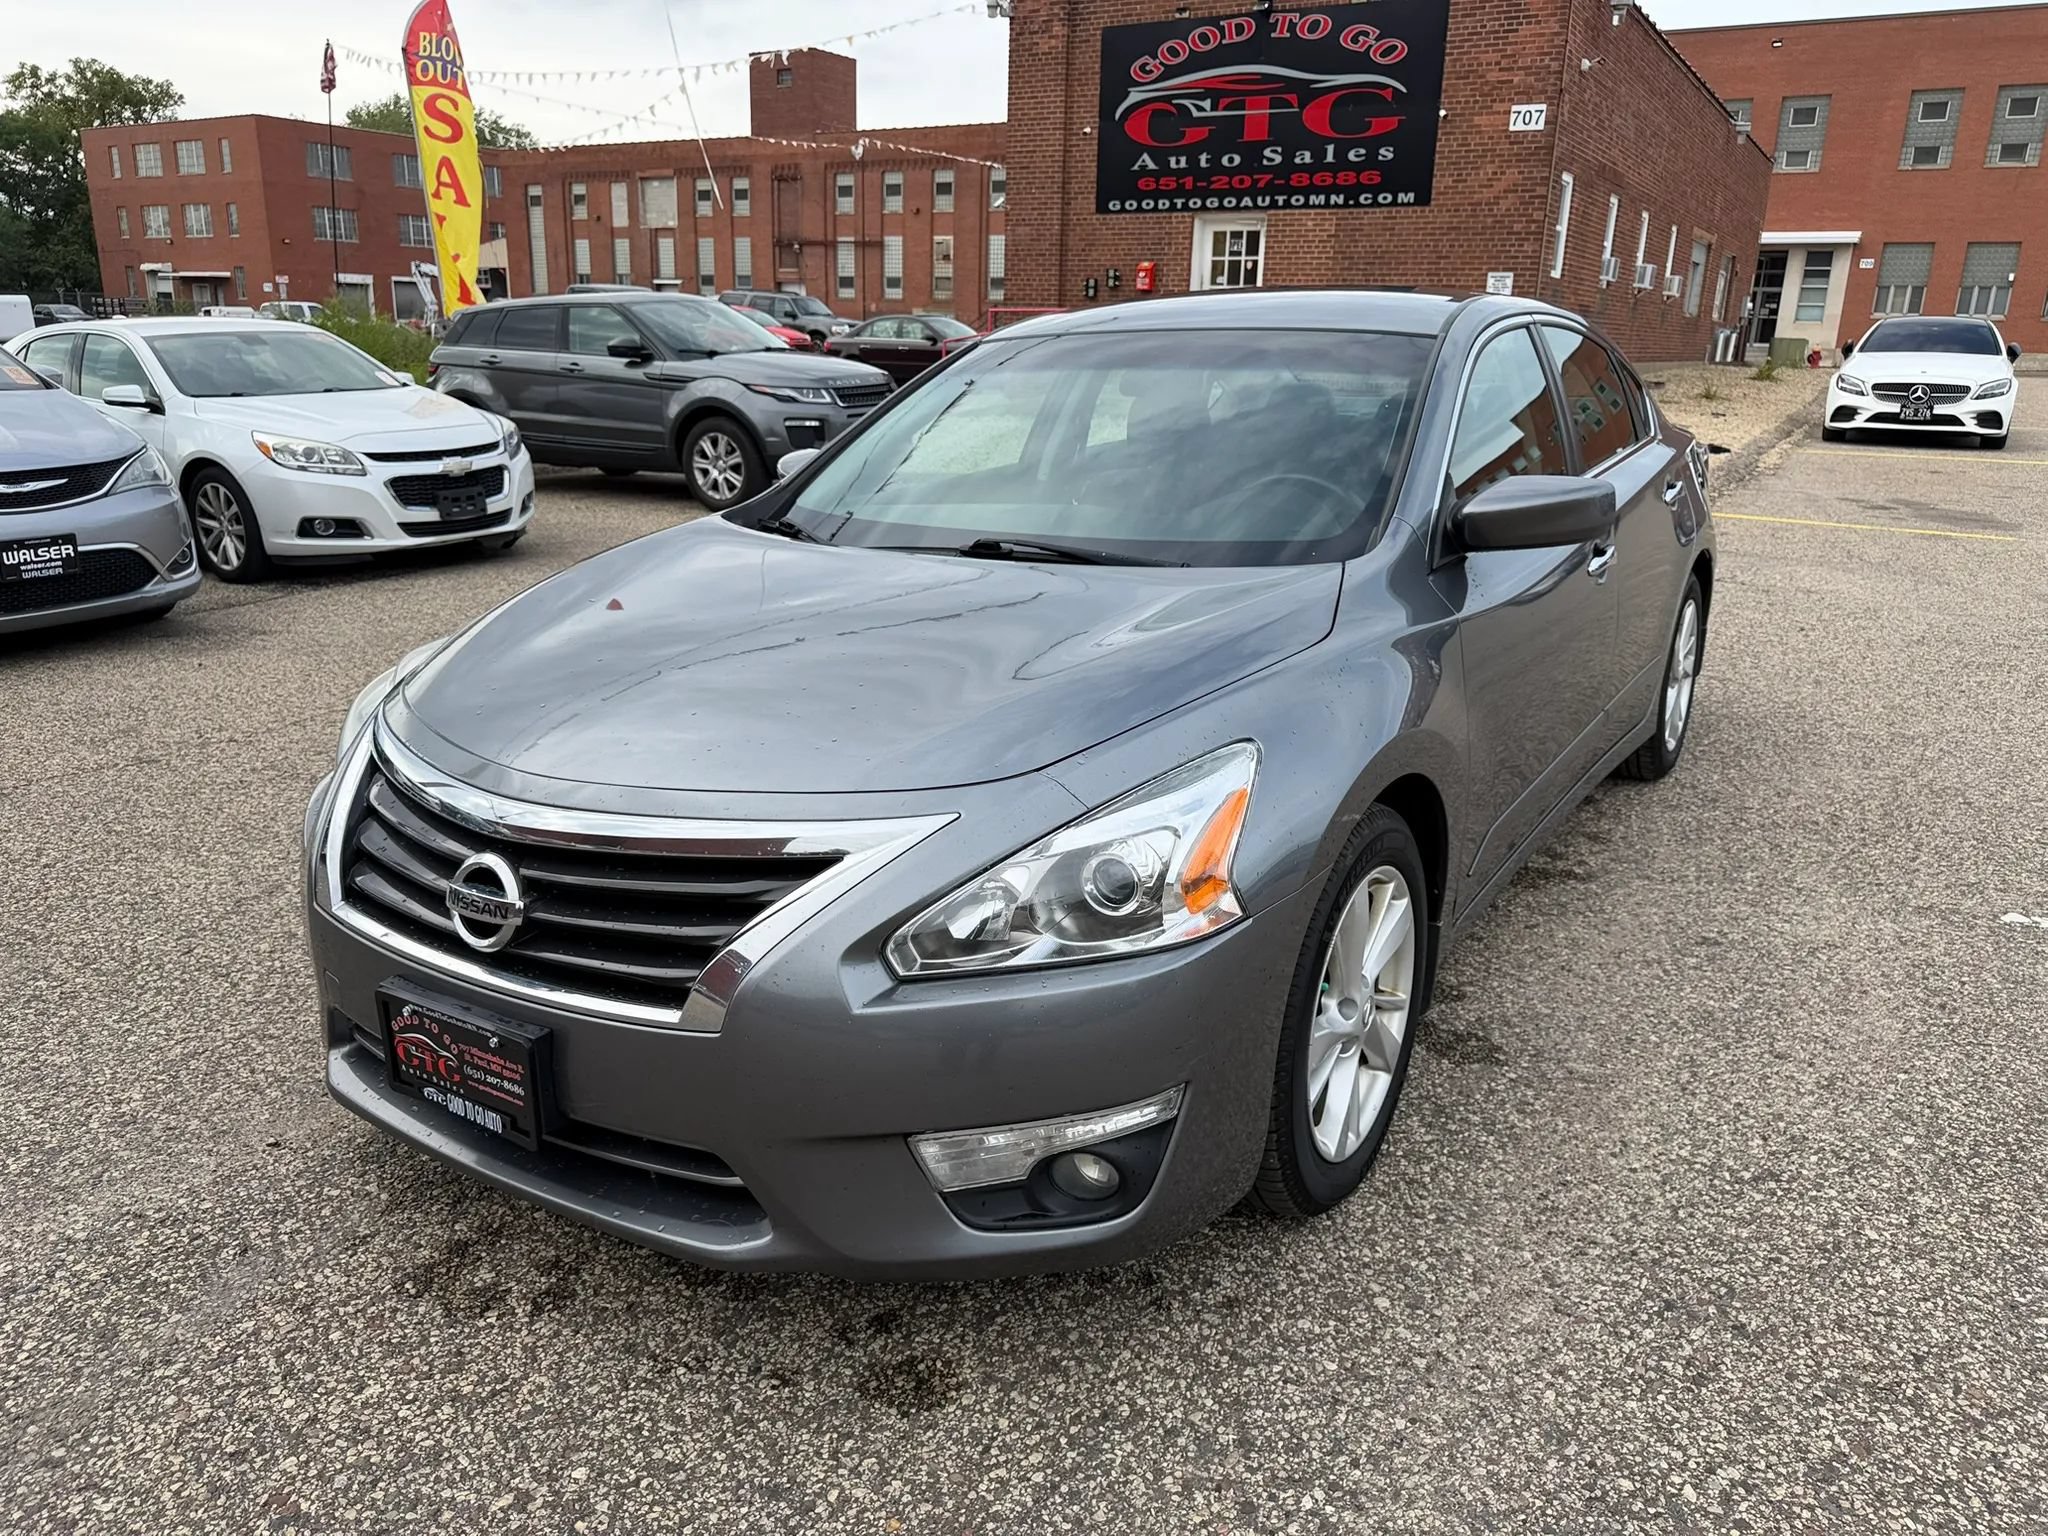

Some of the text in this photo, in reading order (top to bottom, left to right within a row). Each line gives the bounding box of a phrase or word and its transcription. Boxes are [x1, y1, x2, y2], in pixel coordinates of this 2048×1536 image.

[1130, 13, 1408, 82] GOOD TO GO
[1124, 87, 1407, 147] GTG
[1512, 110, 1544, 126] 707
[1130, 144, 1395, 170] Auto Sales
[1137, 170, 1382, 191] 651-207-8686
[1108, 192, 1415, 211] GOODTOGOAUTOMN.COM
[2, 544, 75, 565] WALSER
[20, 560, 63, 571] walser.com
[22, 567, 64, 579] WALSER
[448, 884, 509, 919] NISSAN
[423, 1017, 440, 1034] TO
[463, 1064, 485, 1081] (651)
[485, 1075, 525, 1096] 207-8686
[447, 1093, 465, 1117] GOOD
[465, 1101, 474, 1121] TO
[474, 1105, 484, 1126] GO
[484, 1109, 503, 1134] AUTO
